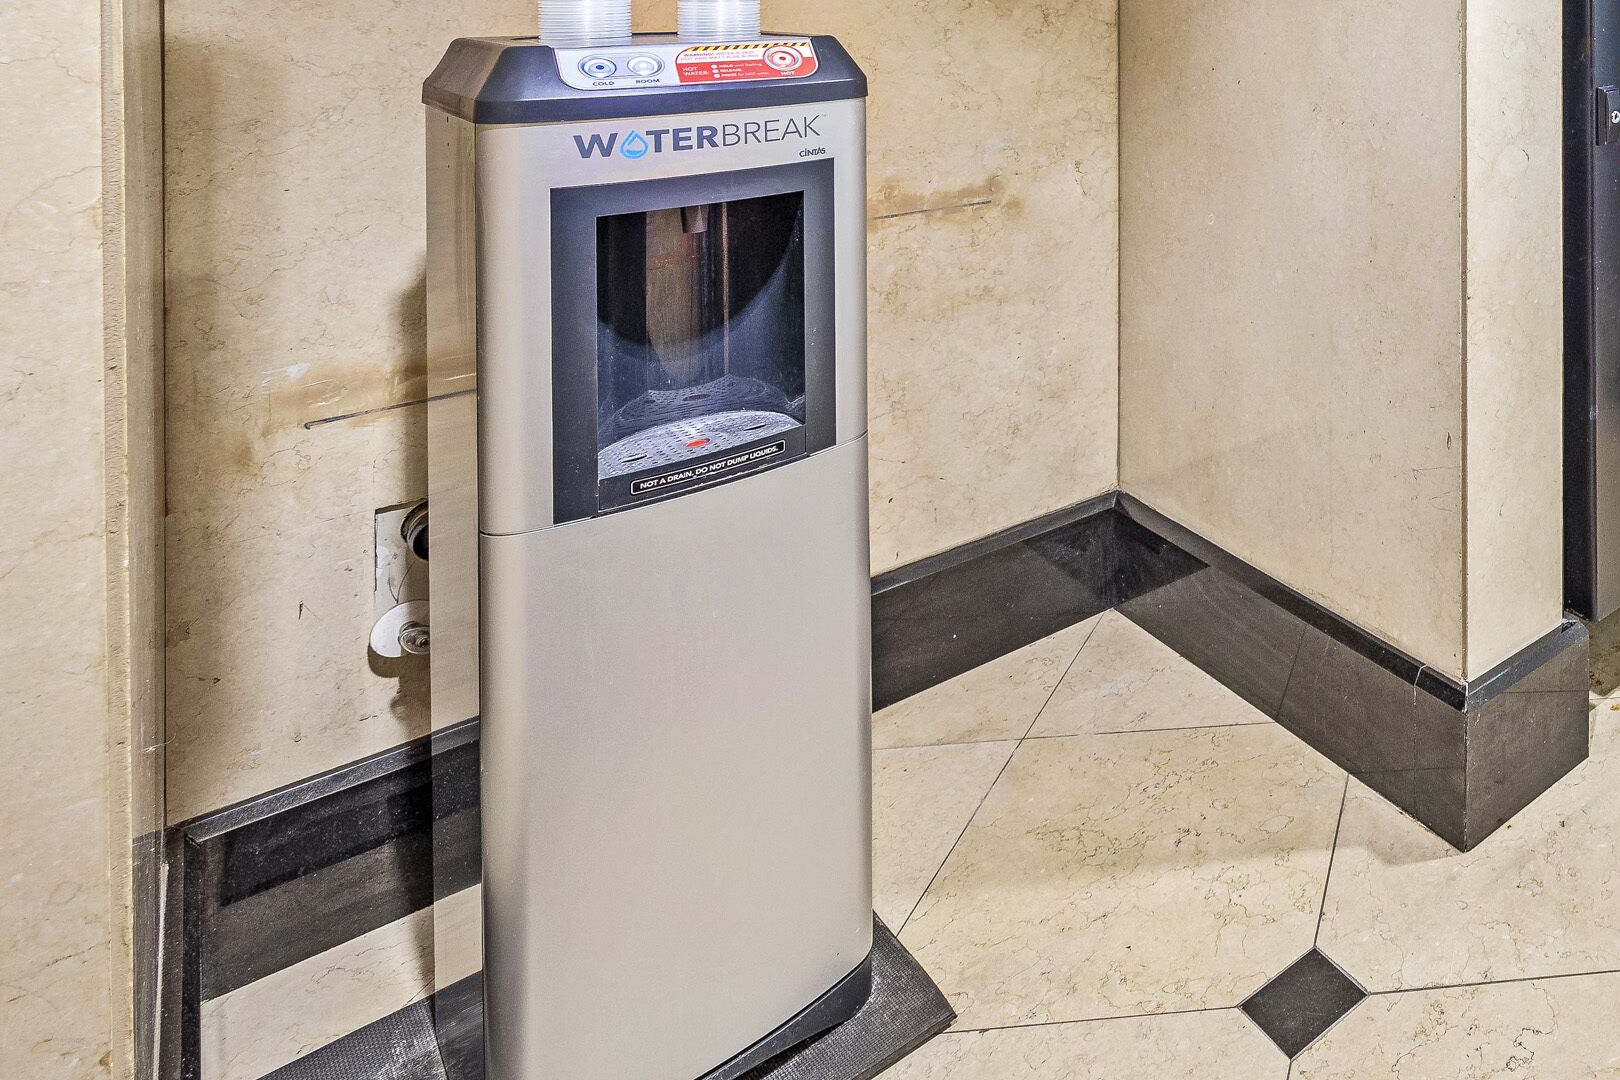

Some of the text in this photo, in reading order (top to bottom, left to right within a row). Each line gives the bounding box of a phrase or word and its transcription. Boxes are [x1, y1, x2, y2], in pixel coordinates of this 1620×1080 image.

[639, 480, 658, 490] NOT
[659, 478, 668, 486] A
[695, 465, 709, 476] DO
[709, 461, 727, 472] NOT
[727, 454, 749, 467] DUMP
